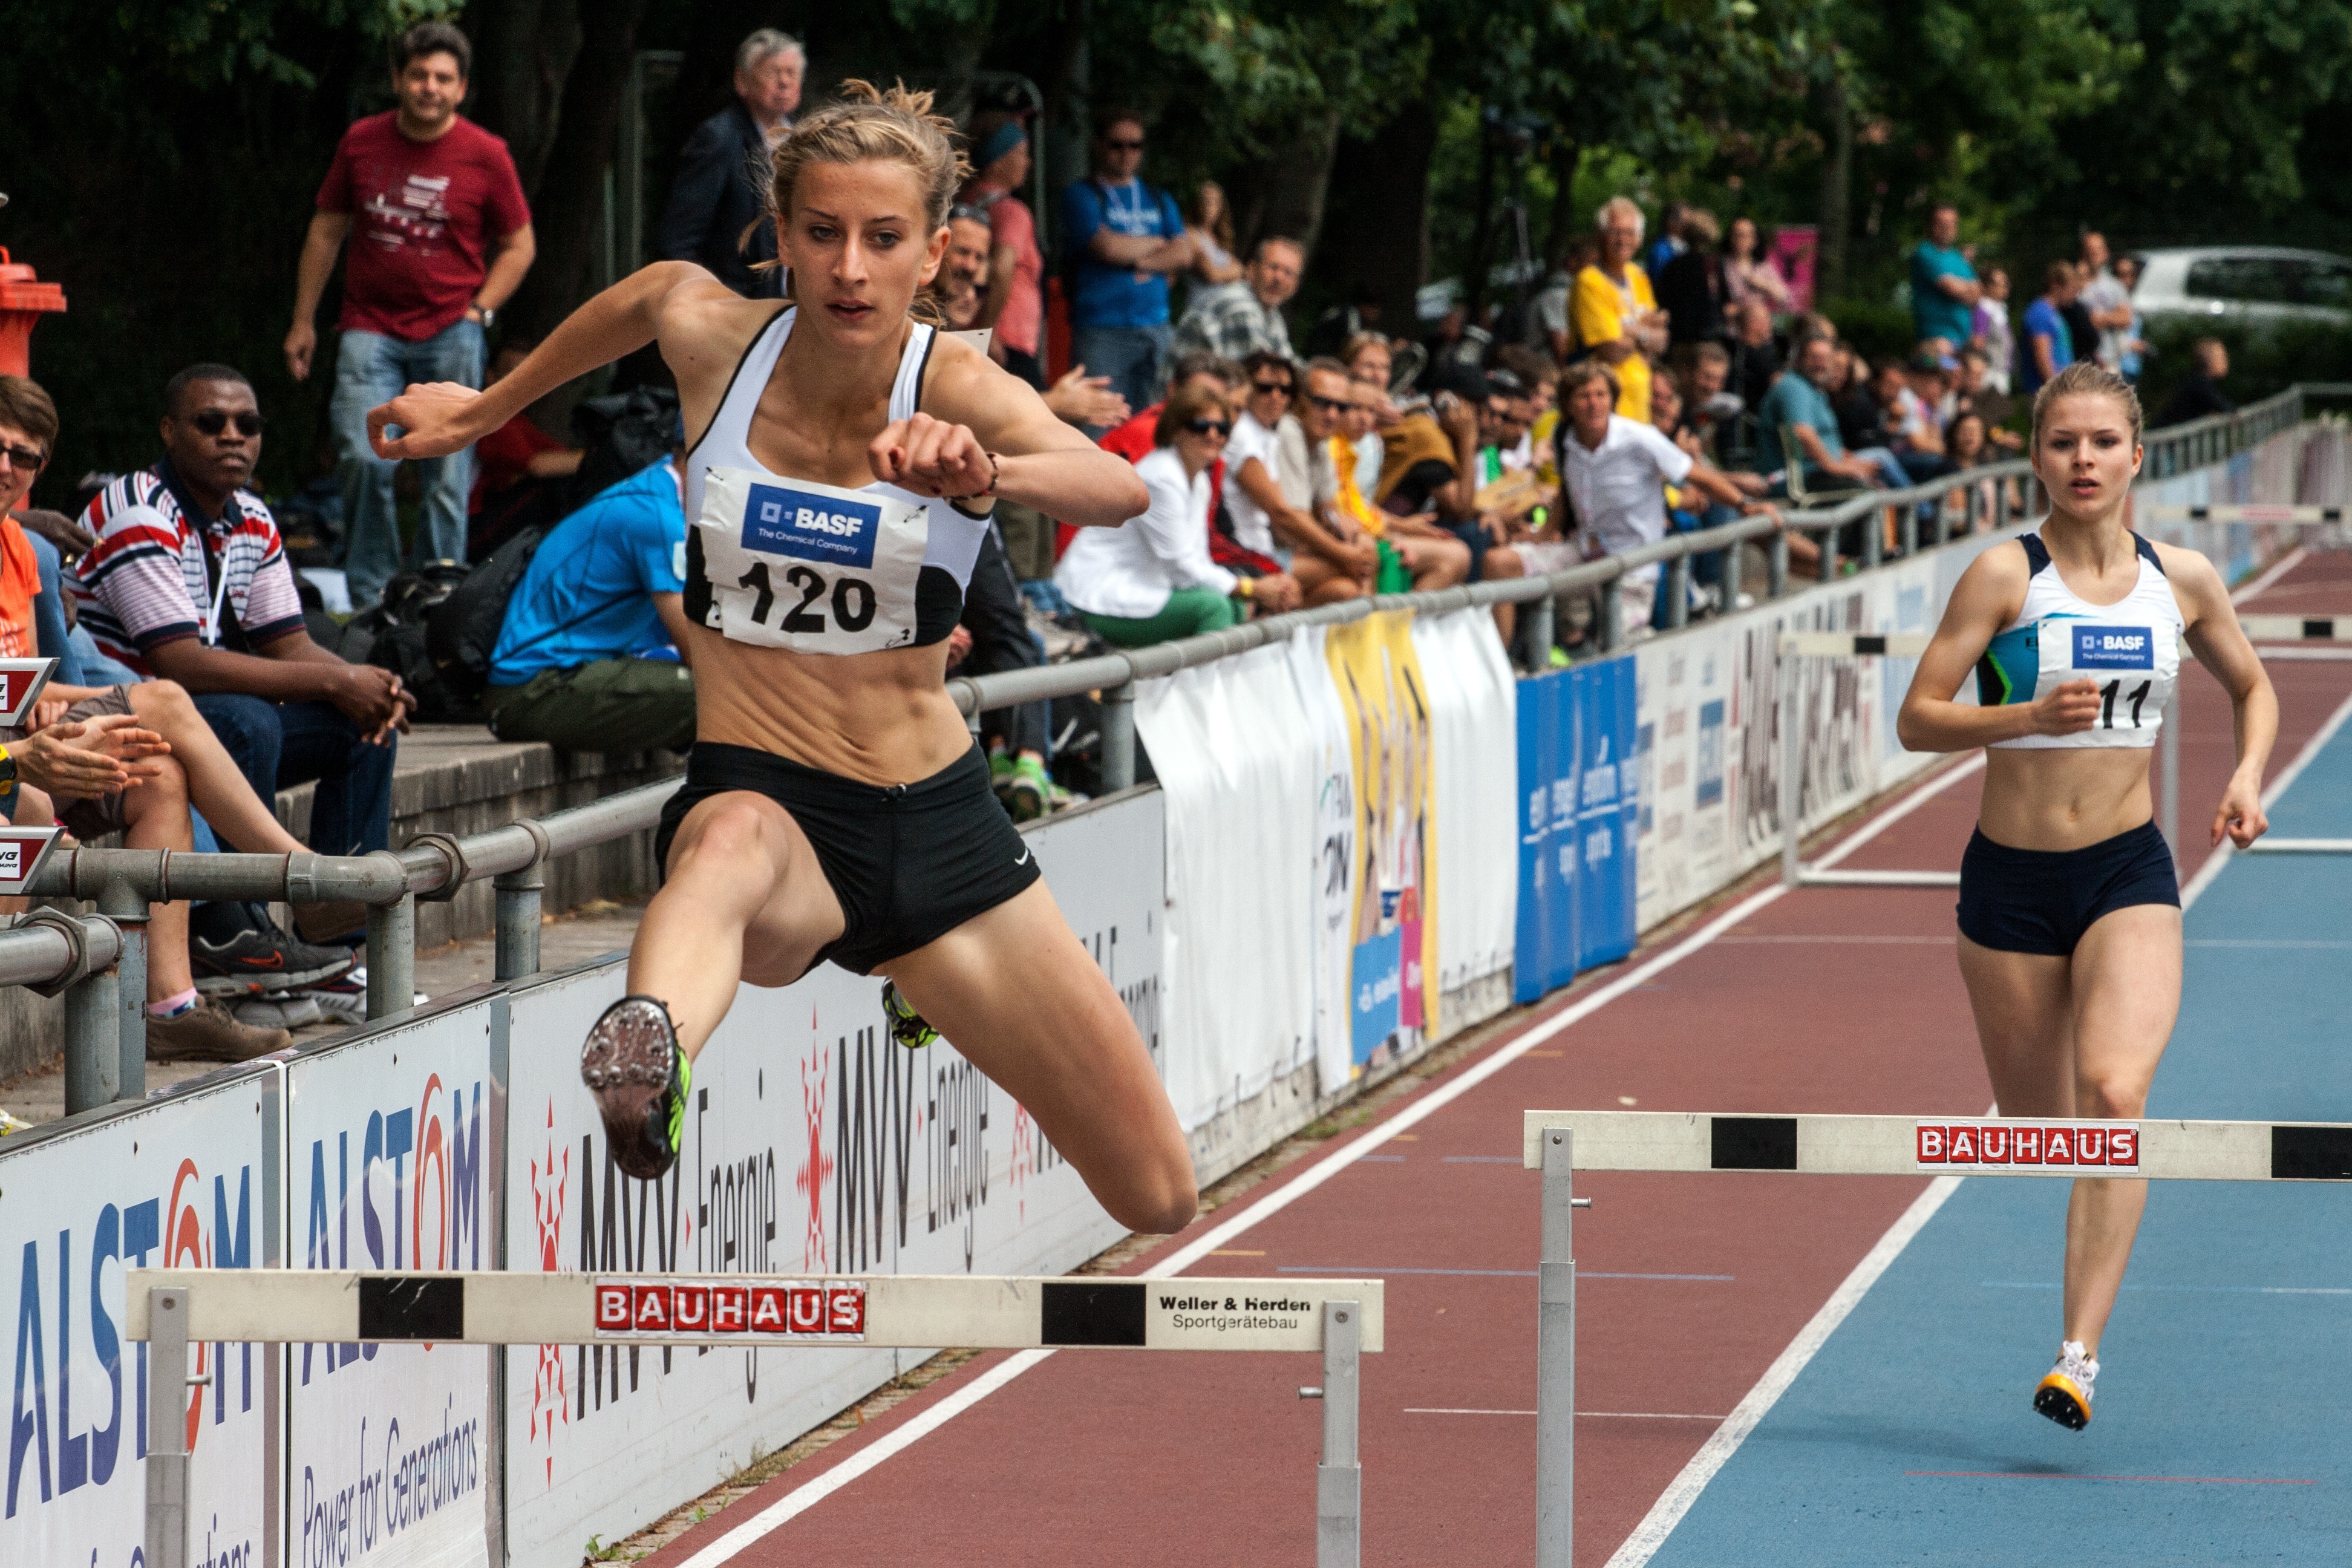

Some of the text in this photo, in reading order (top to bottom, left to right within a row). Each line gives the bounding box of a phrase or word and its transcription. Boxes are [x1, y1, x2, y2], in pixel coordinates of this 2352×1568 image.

[795, 507, 863, 537] BASF
[759, 528, 858, 555] The Chemical Company
[738, 562, 876, 633] 120
[2103, 635, 2145, 650] BASF
[834, 1018, 913, 1274] MVV
[1921, 1131, 2134, 1159] BAUHAUS
[302, 1073, 480, 1387] ALSTOM
[601, 1291, 859, 1326] BAUHAUS
[1160, 1296, 1311, 1312] Weller & Herden
[1172, 1314, 1298, 1331] Sportgerätebau
[5, 1158, 252, 1520] ALSTOM
[303, 1465, 354, 1568] Power
[359, 1416, 381, 1554] for
[385, 1391, 477, 1538] Generations
